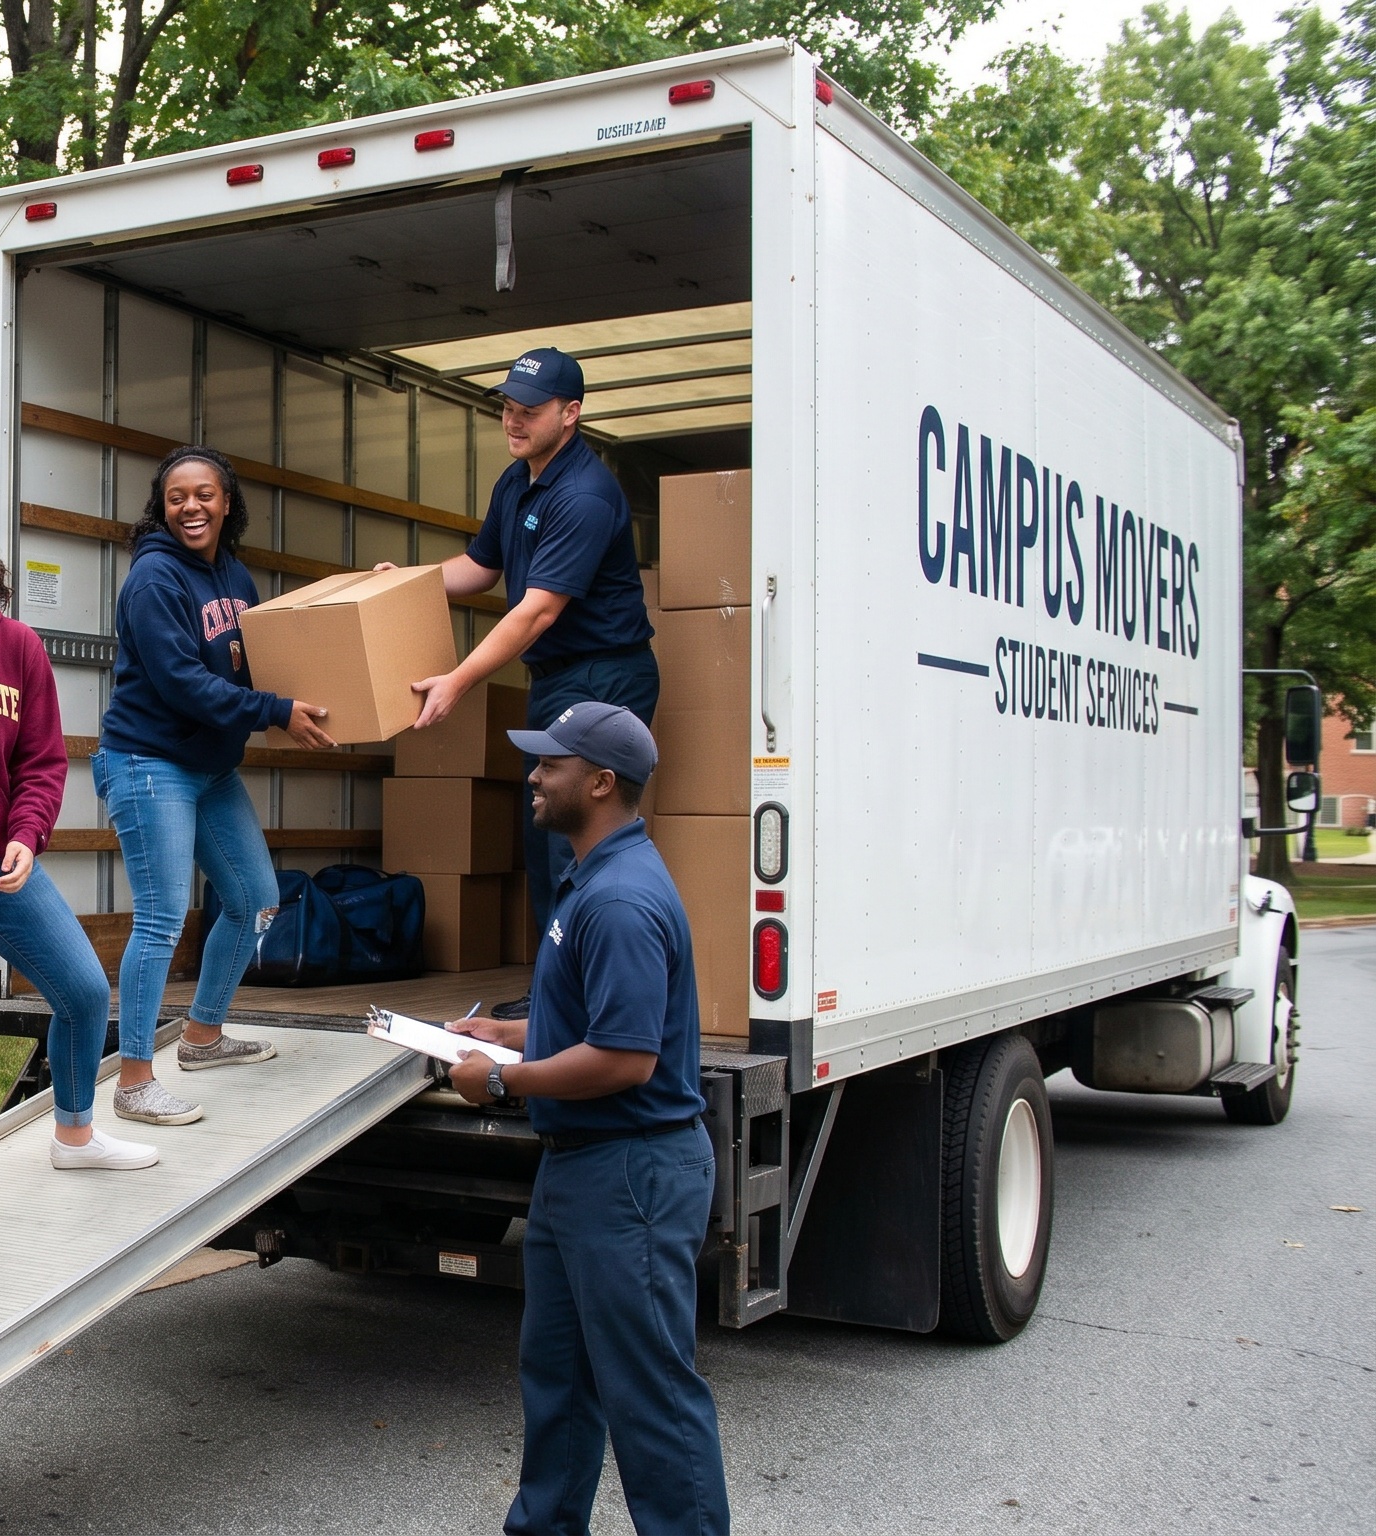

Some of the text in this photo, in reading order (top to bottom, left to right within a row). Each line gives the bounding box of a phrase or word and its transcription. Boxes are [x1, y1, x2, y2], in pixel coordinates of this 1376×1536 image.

[918, 404, 1201, 661] CAMPUS MOVERS
[994, 636, 1159, 735] STUDENT SERVICES
